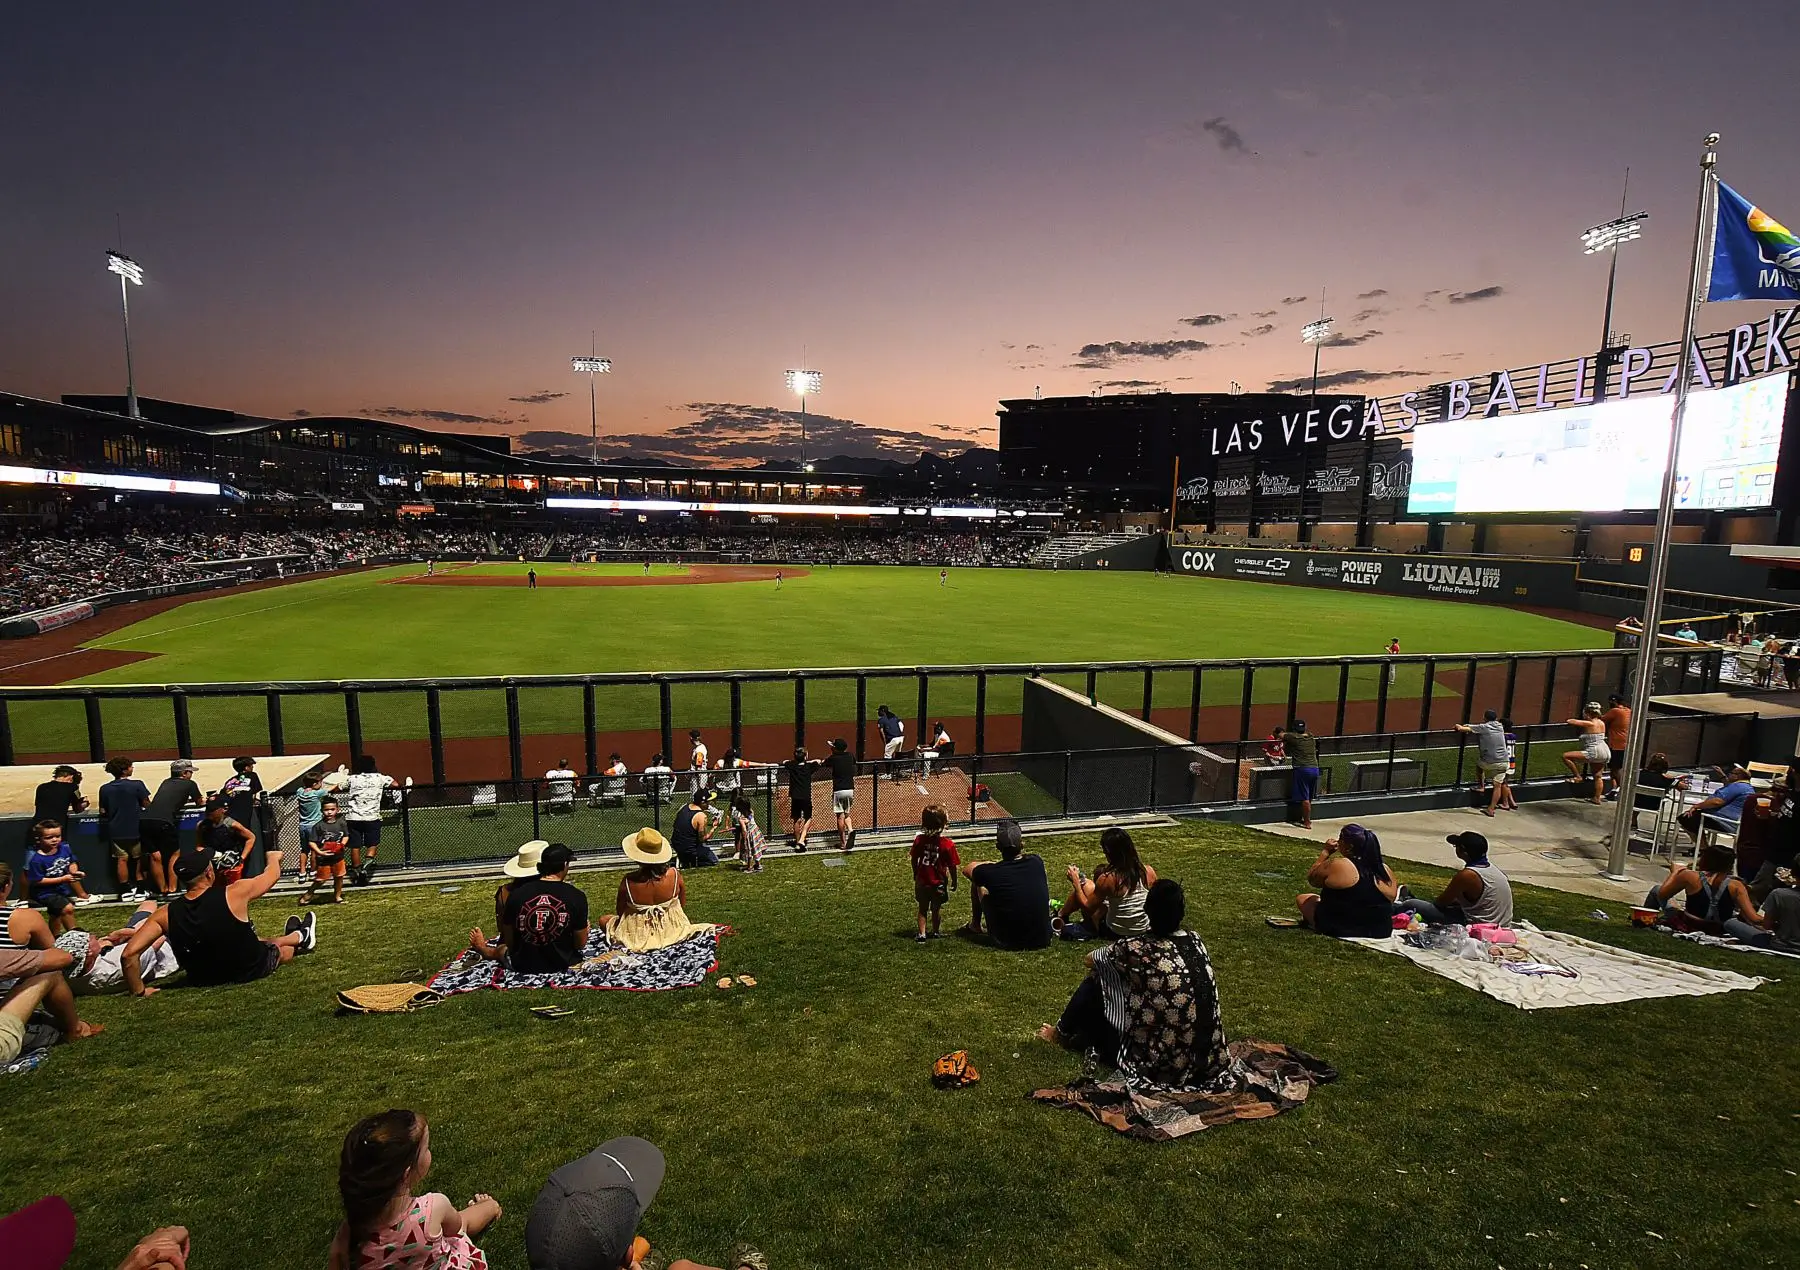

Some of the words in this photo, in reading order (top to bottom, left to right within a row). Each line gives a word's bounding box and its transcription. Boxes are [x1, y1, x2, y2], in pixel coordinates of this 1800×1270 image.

[1211, 419, 1263, 456] LAS
[1281, 392, 1419, 446] VEGAS
[1447, 308, 1797, 422] BALLPARK
[1213, 477, 1229, 490] red
[1229, 475, 1250, 489] rock
[1182, 550, 1216, 572] COX
[1234, 558, 1264, 566] CHEVROLET
[1341, 560, 1382, 574] POWER
[1342, 572, 1379, 585] ALLEY
[1402, 563, 1482, 587] LiUNA!
[1482, 567, 1500, 577] LOCAL
[1482, 575, 1500, 588] 872
[1428, 584, 1442, 592] Feel
[1442, 584, 1453, 593] the
[1454, 586, 1479, 596] Power!
